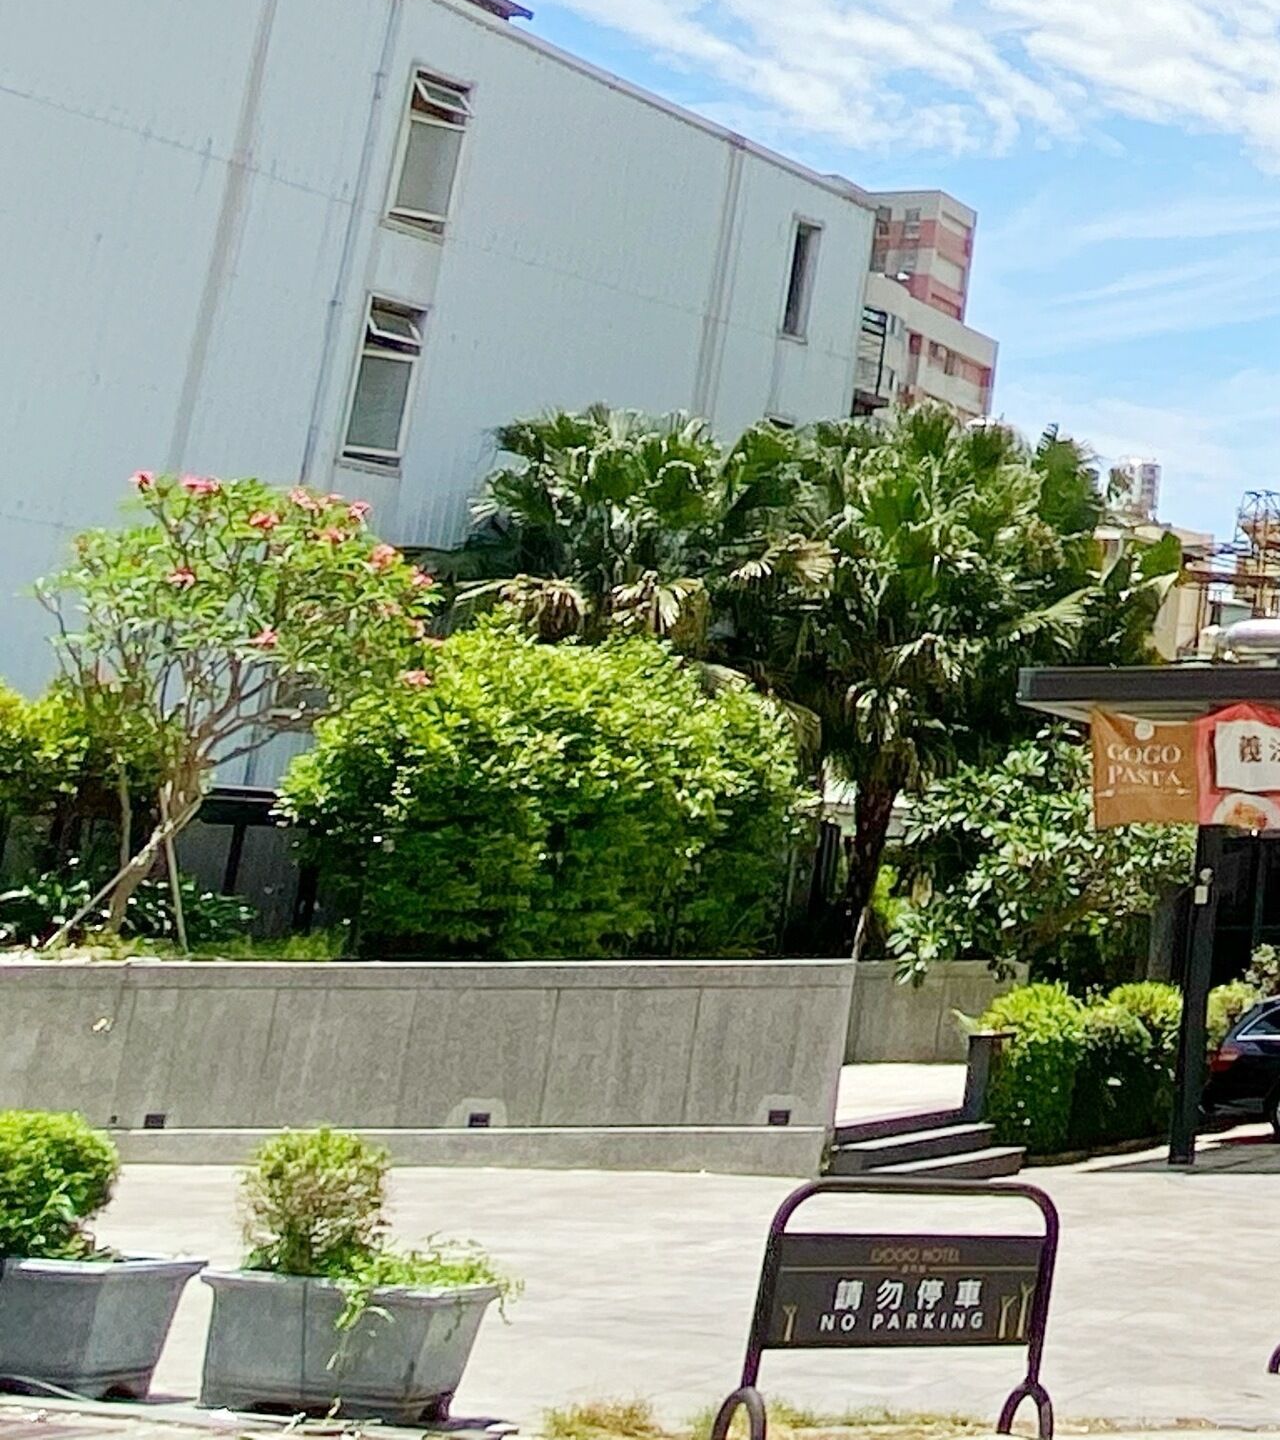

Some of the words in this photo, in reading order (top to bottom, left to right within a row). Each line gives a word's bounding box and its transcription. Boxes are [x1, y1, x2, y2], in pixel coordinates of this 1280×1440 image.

[1106, 743, 1181, 765] GOGO
[1107, 765, 1183, 786] PASTA
[833, 1279, 983, 1311] 請勿停車
[819, 1313, 856, 1332] NO
[871, 1312, 984, 1330] PARKING
